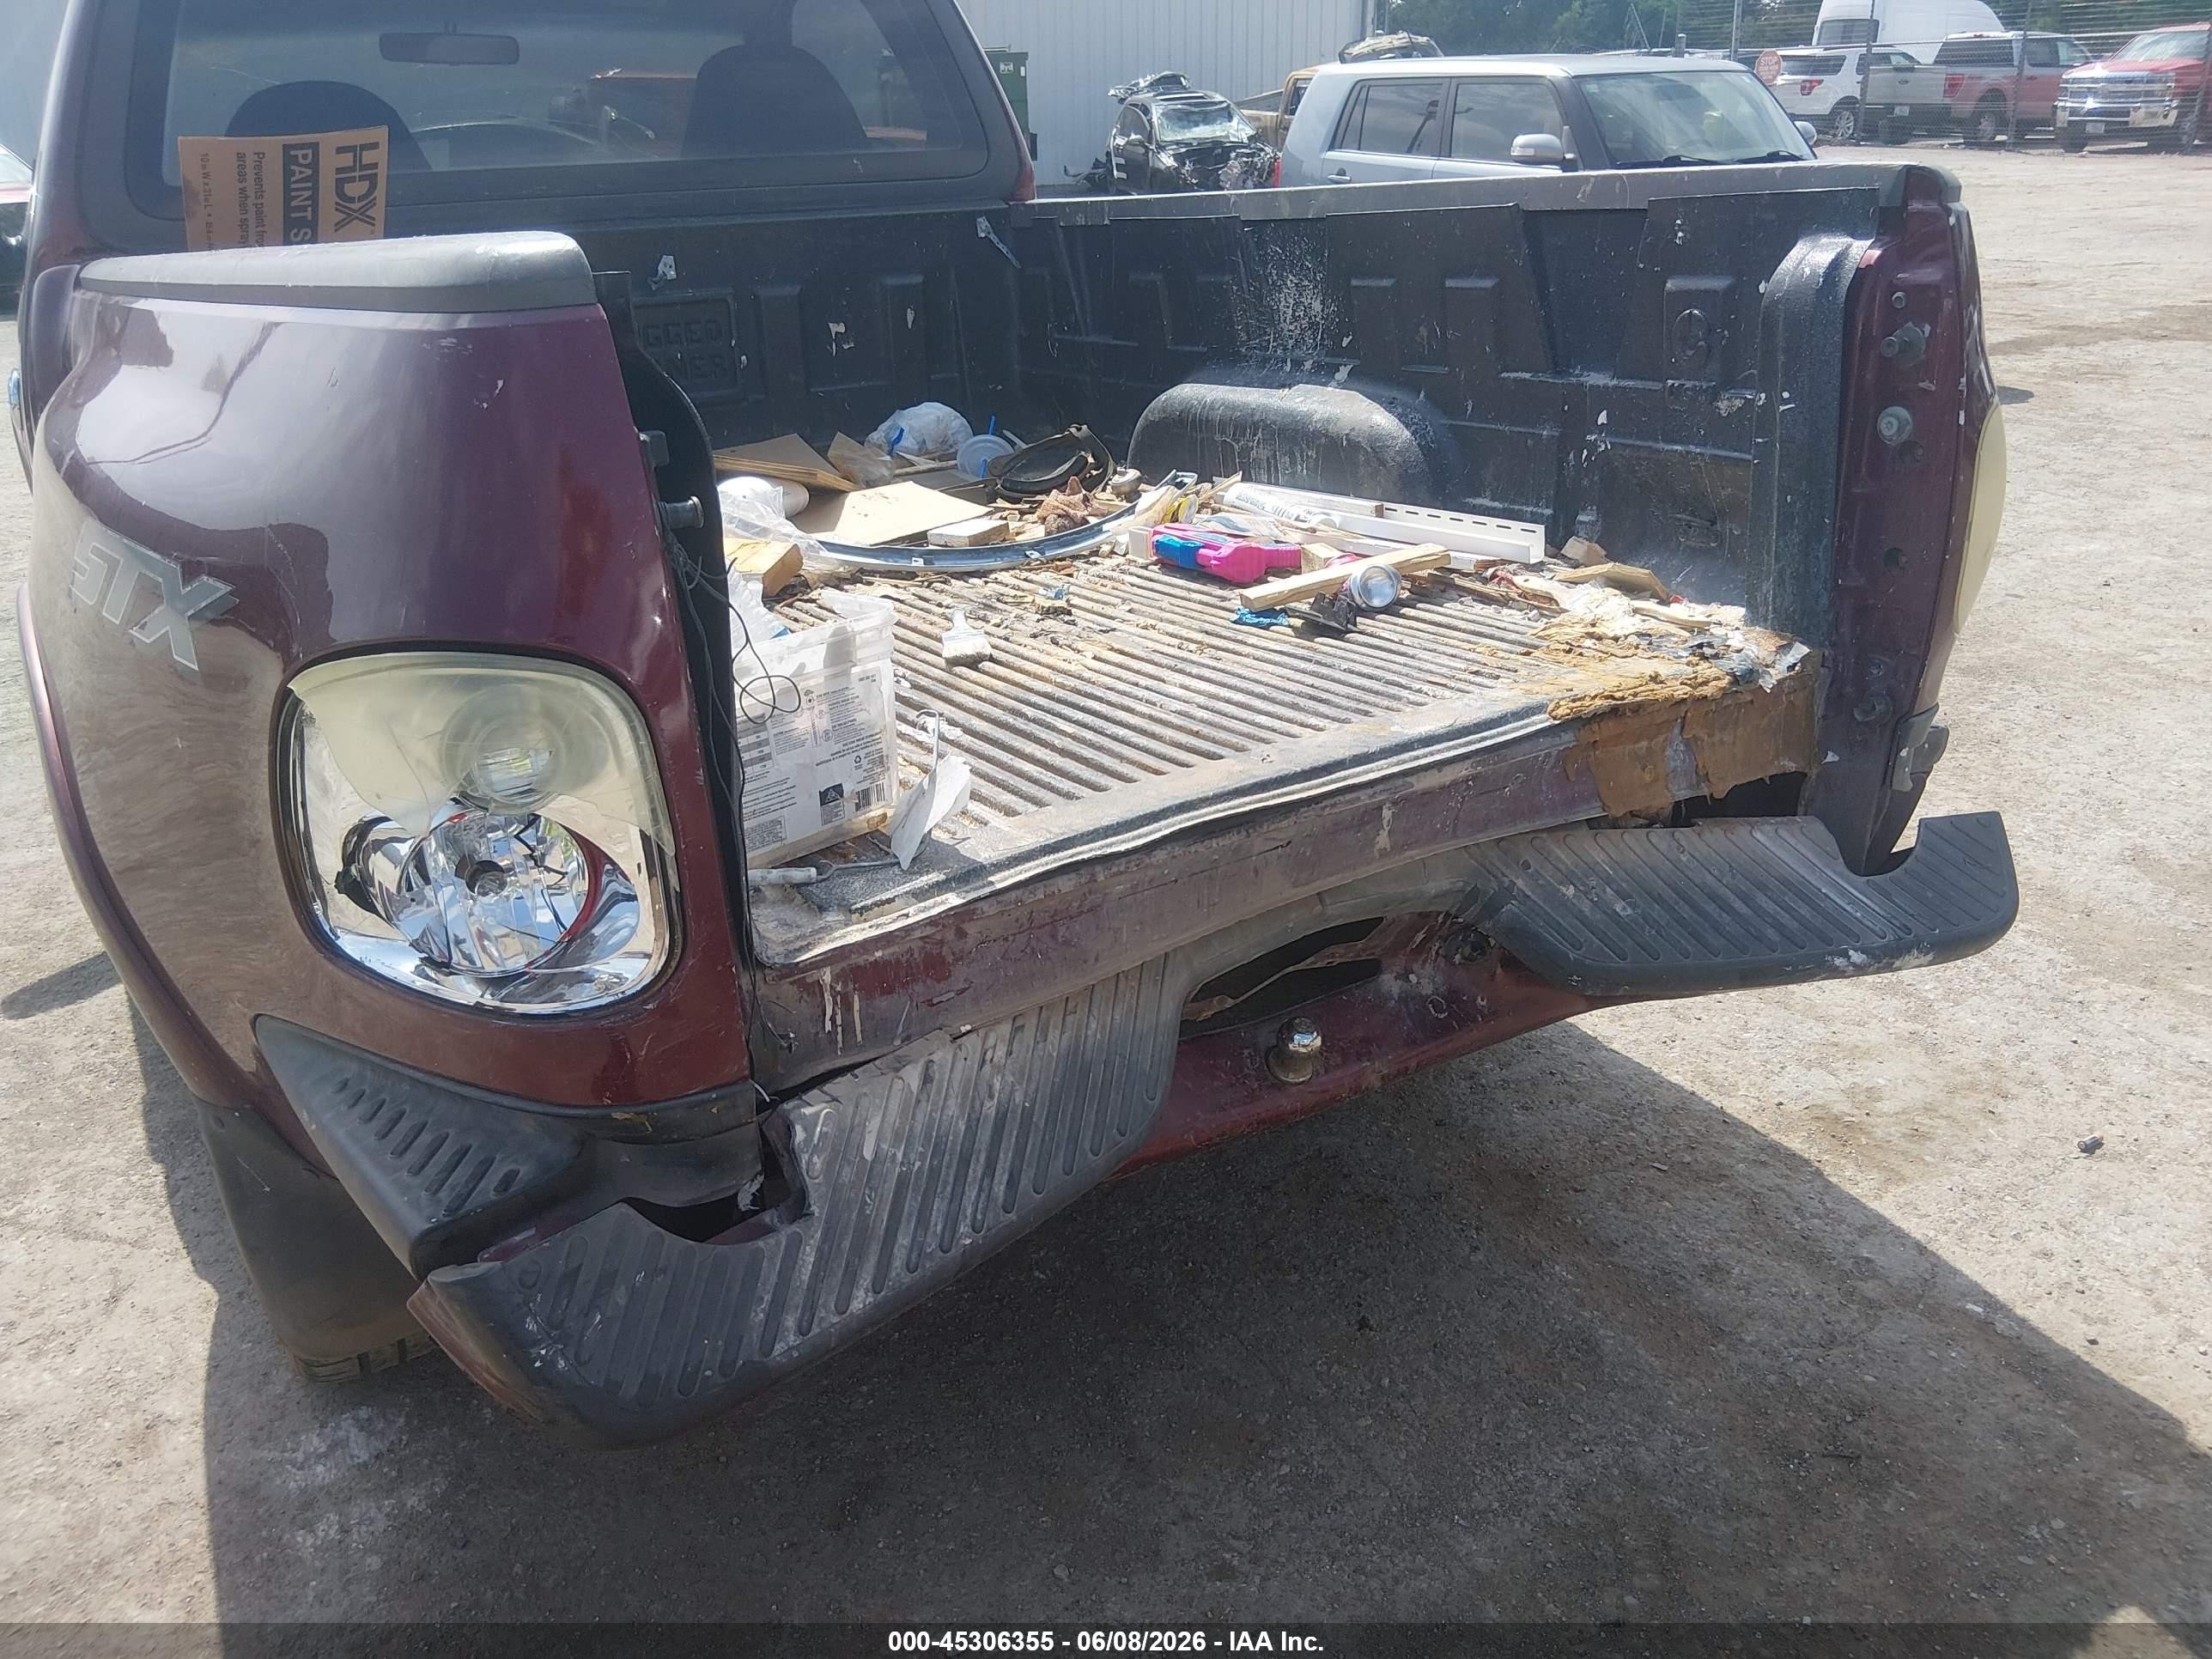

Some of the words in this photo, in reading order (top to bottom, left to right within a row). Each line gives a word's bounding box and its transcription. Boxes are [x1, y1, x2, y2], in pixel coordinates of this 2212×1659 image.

[1759, 56, 1778, 66] STOP
[236, 152, 248, 184] areas
[253, 151, 266, 200] Prevents
[290, 149, 313, 221] PAINT
[334, 142, 380, 234] HDX
[239, 186, 251, 216] when
[252, 203, 268, 228] paint
[237, 217, 250, 246] spray
[289, 228, 313, 241] S
[68, 519, 236, 672] STX
